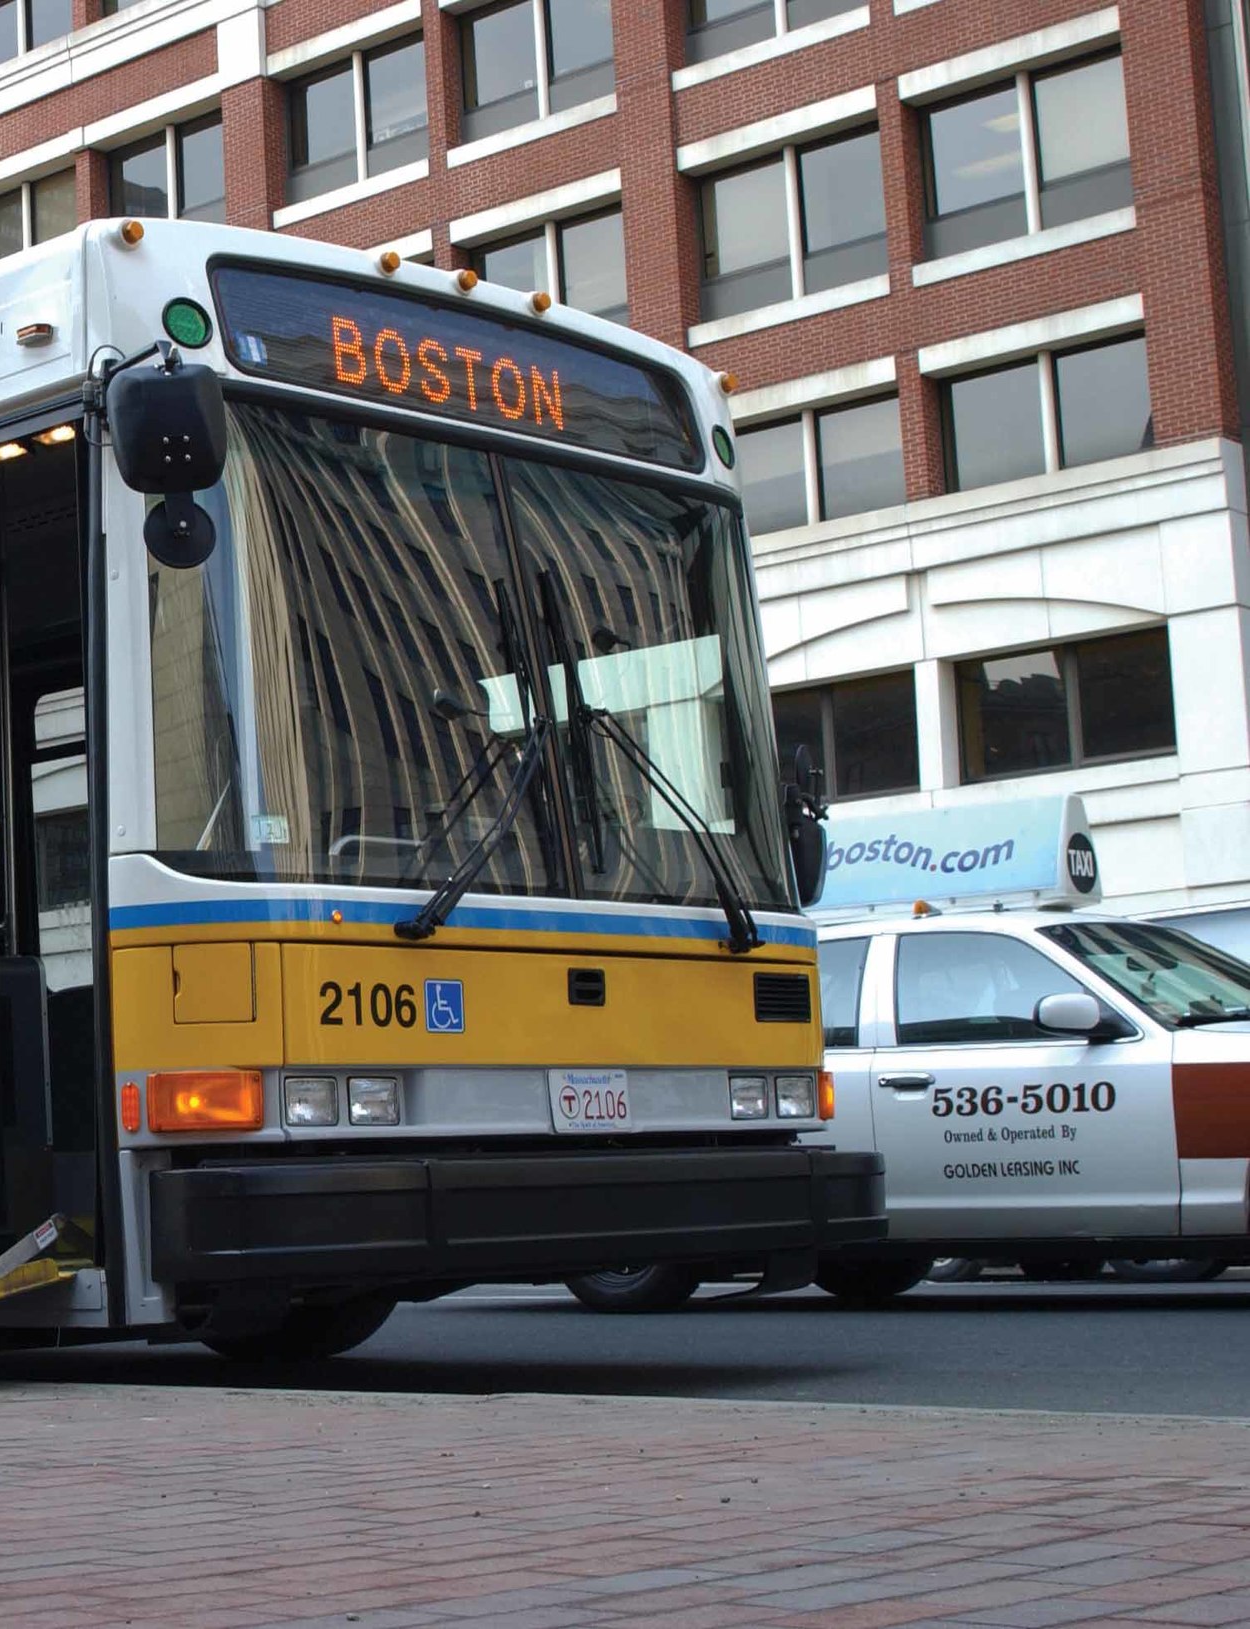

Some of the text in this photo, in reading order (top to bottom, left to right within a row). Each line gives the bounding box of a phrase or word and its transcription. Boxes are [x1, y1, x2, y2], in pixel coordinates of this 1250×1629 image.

[331, 315, 565, 431] BOSTON
[1068, 849, 1095, 878] TAXI
[319, 981, 417, 1028] 2106
[582, 1090, 627, 1120] 2106
[932, 1081, 1116, 1118] 536-5010
[944, 1124, 1077, 1144] Owned & Operated By
[943, 1159, 1081, 1179] GOLDEN LEASING INC
